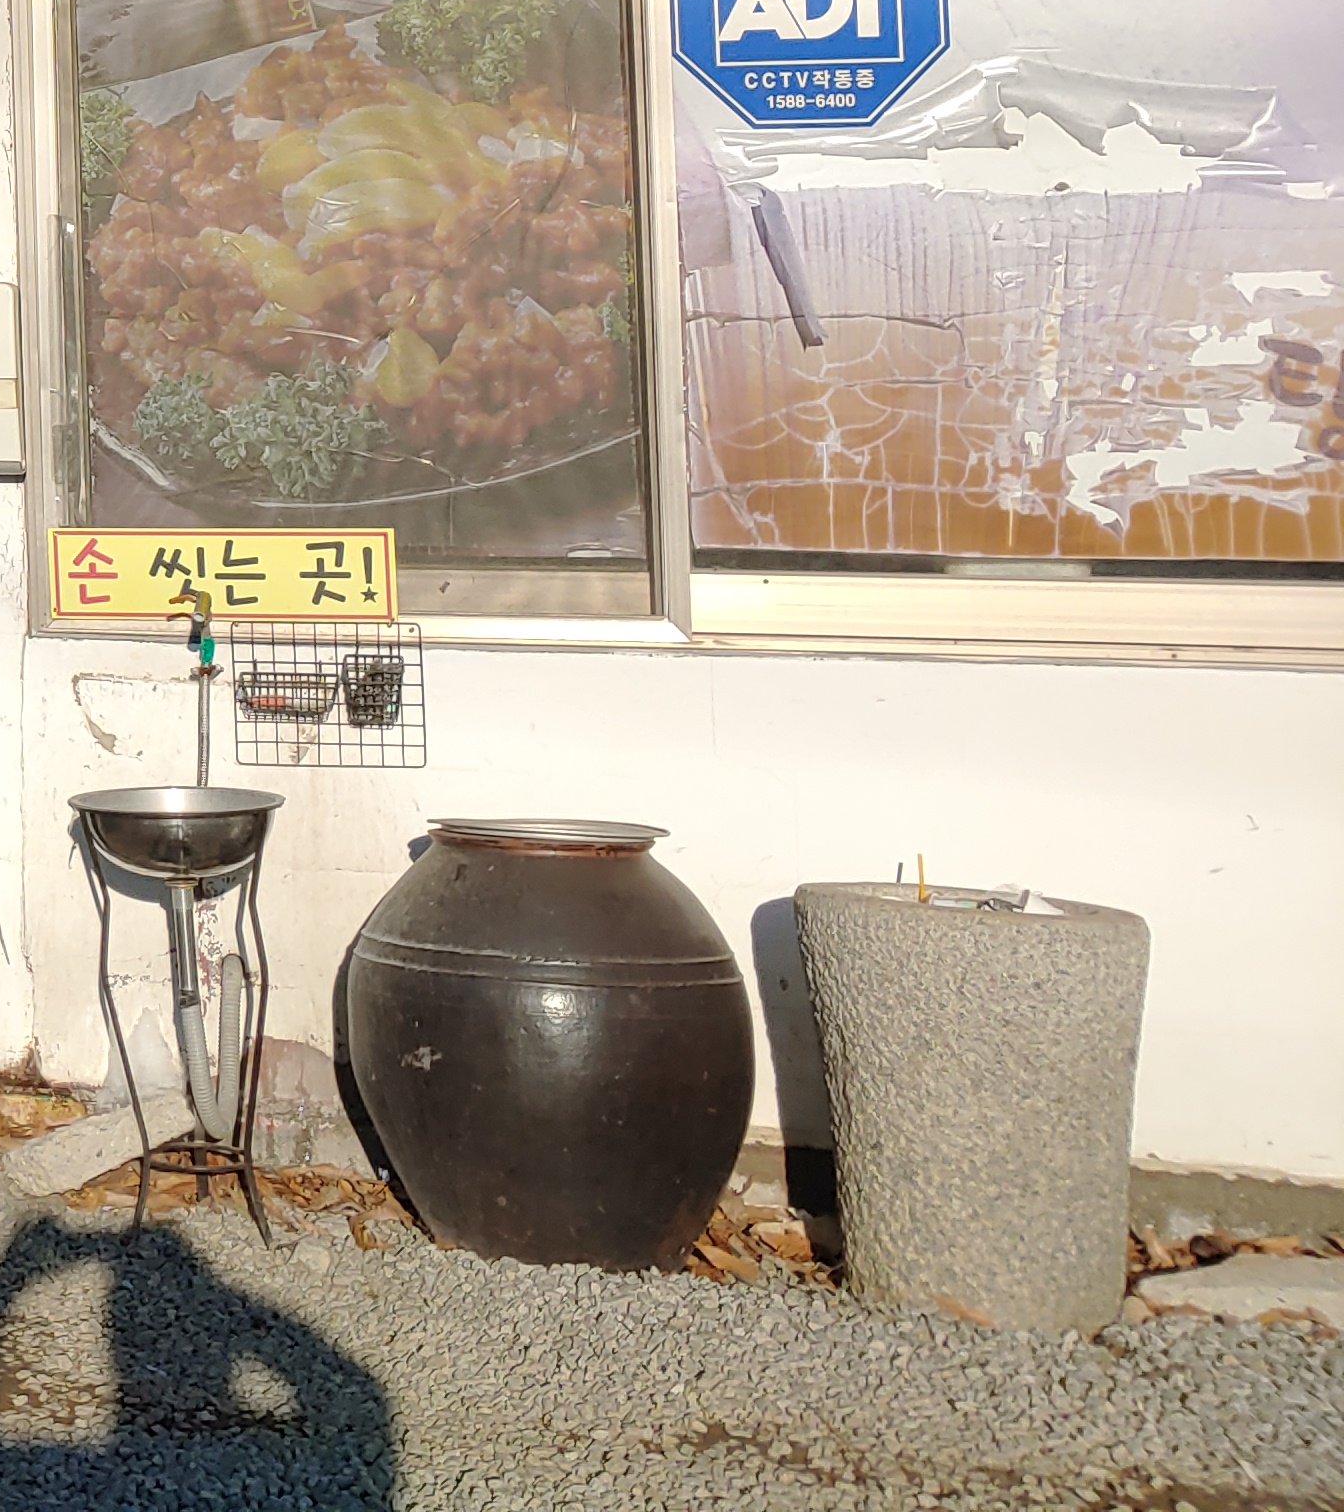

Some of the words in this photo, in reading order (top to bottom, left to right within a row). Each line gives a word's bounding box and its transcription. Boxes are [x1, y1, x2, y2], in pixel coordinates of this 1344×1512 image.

[744, 69, 875, 90] CCTV작동중
[765, 93, 856, 109] 1588-6400
[67, 537, 119, 605] 손
[148, 538, 267, 606] 씻는
[298, 540, 379, 606] 곳!
